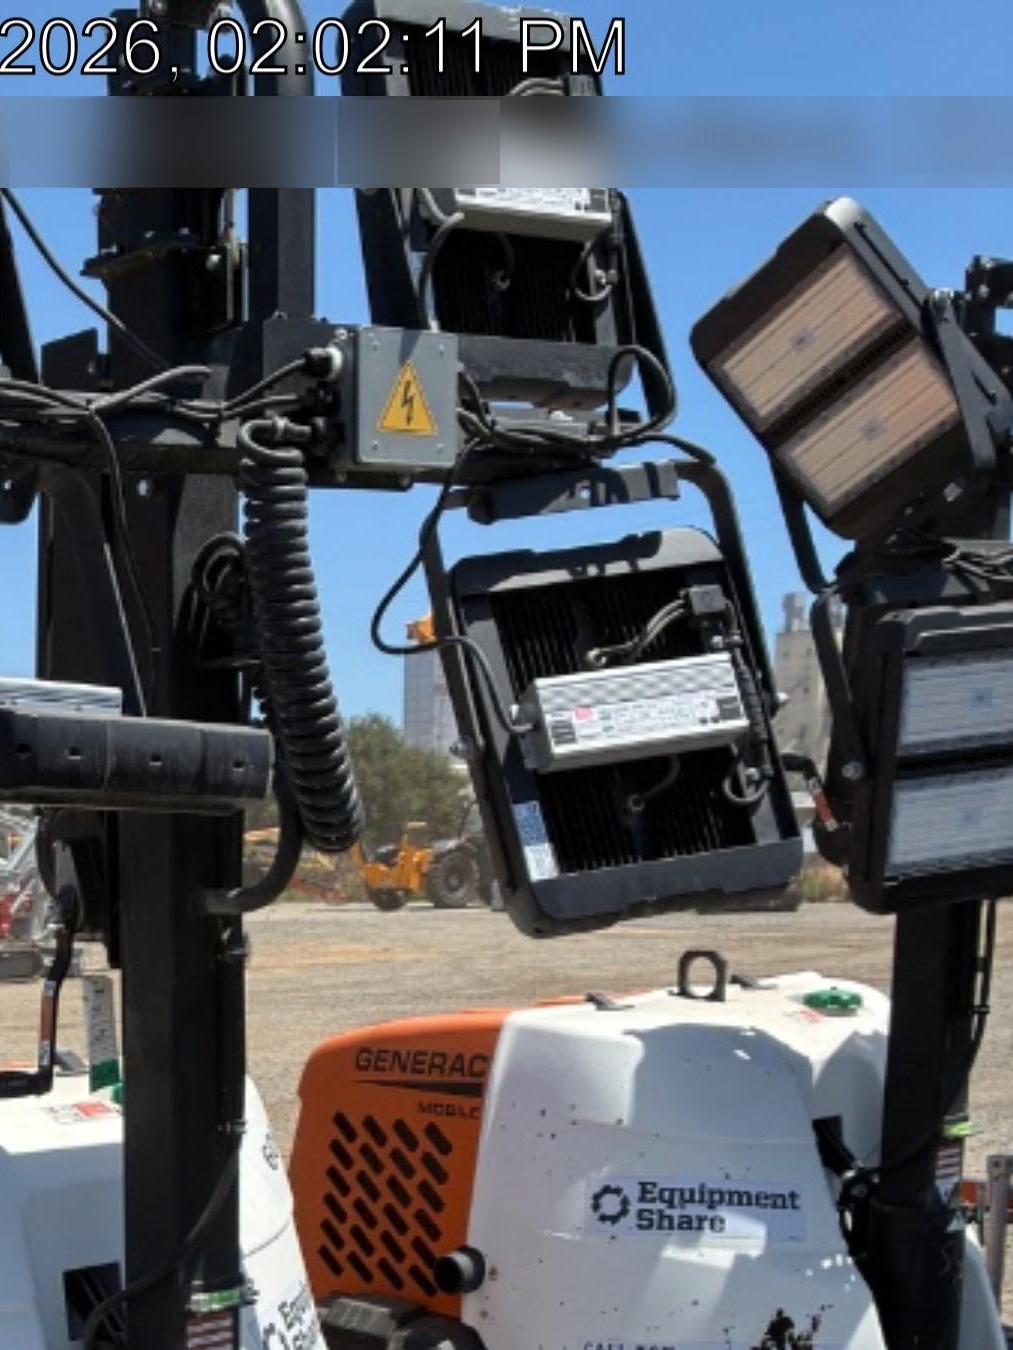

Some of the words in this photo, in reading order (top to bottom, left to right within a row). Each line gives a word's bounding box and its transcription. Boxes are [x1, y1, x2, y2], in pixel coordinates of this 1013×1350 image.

[355, 1048, 490, 1078] GENERAC
[638, 1181, 801, 1210] Equipment
[636, 1208, 726, 1233] Share
